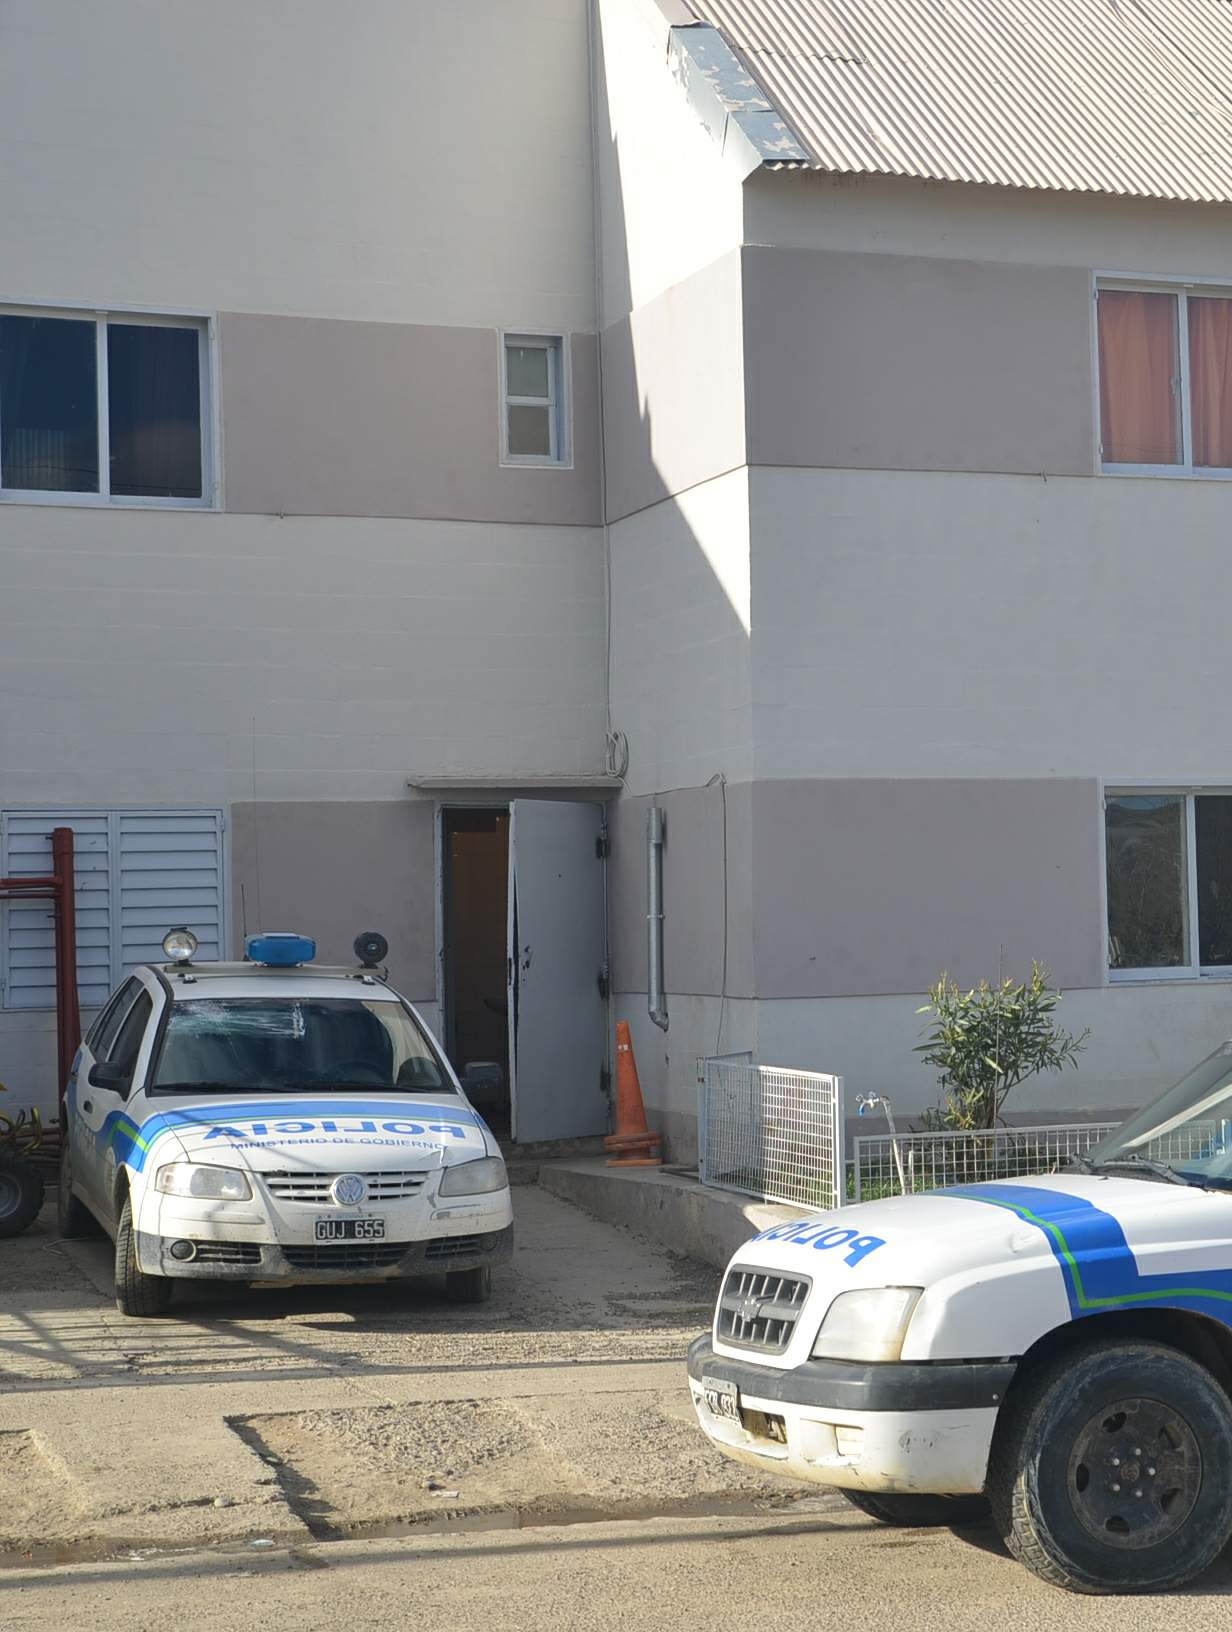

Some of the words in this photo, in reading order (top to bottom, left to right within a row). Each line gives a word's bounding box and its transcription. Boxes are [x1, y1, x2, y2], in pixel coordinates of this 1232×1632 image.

[230, 1137, 326, 1150] MINISTERIO
[329, 1136, 359, 1144] DE
[366, 1138, 449, 1151] GOBIERNO
[316, 1221, 345, 1239] GUJ
[354, 1220, 384, 1238] 655
